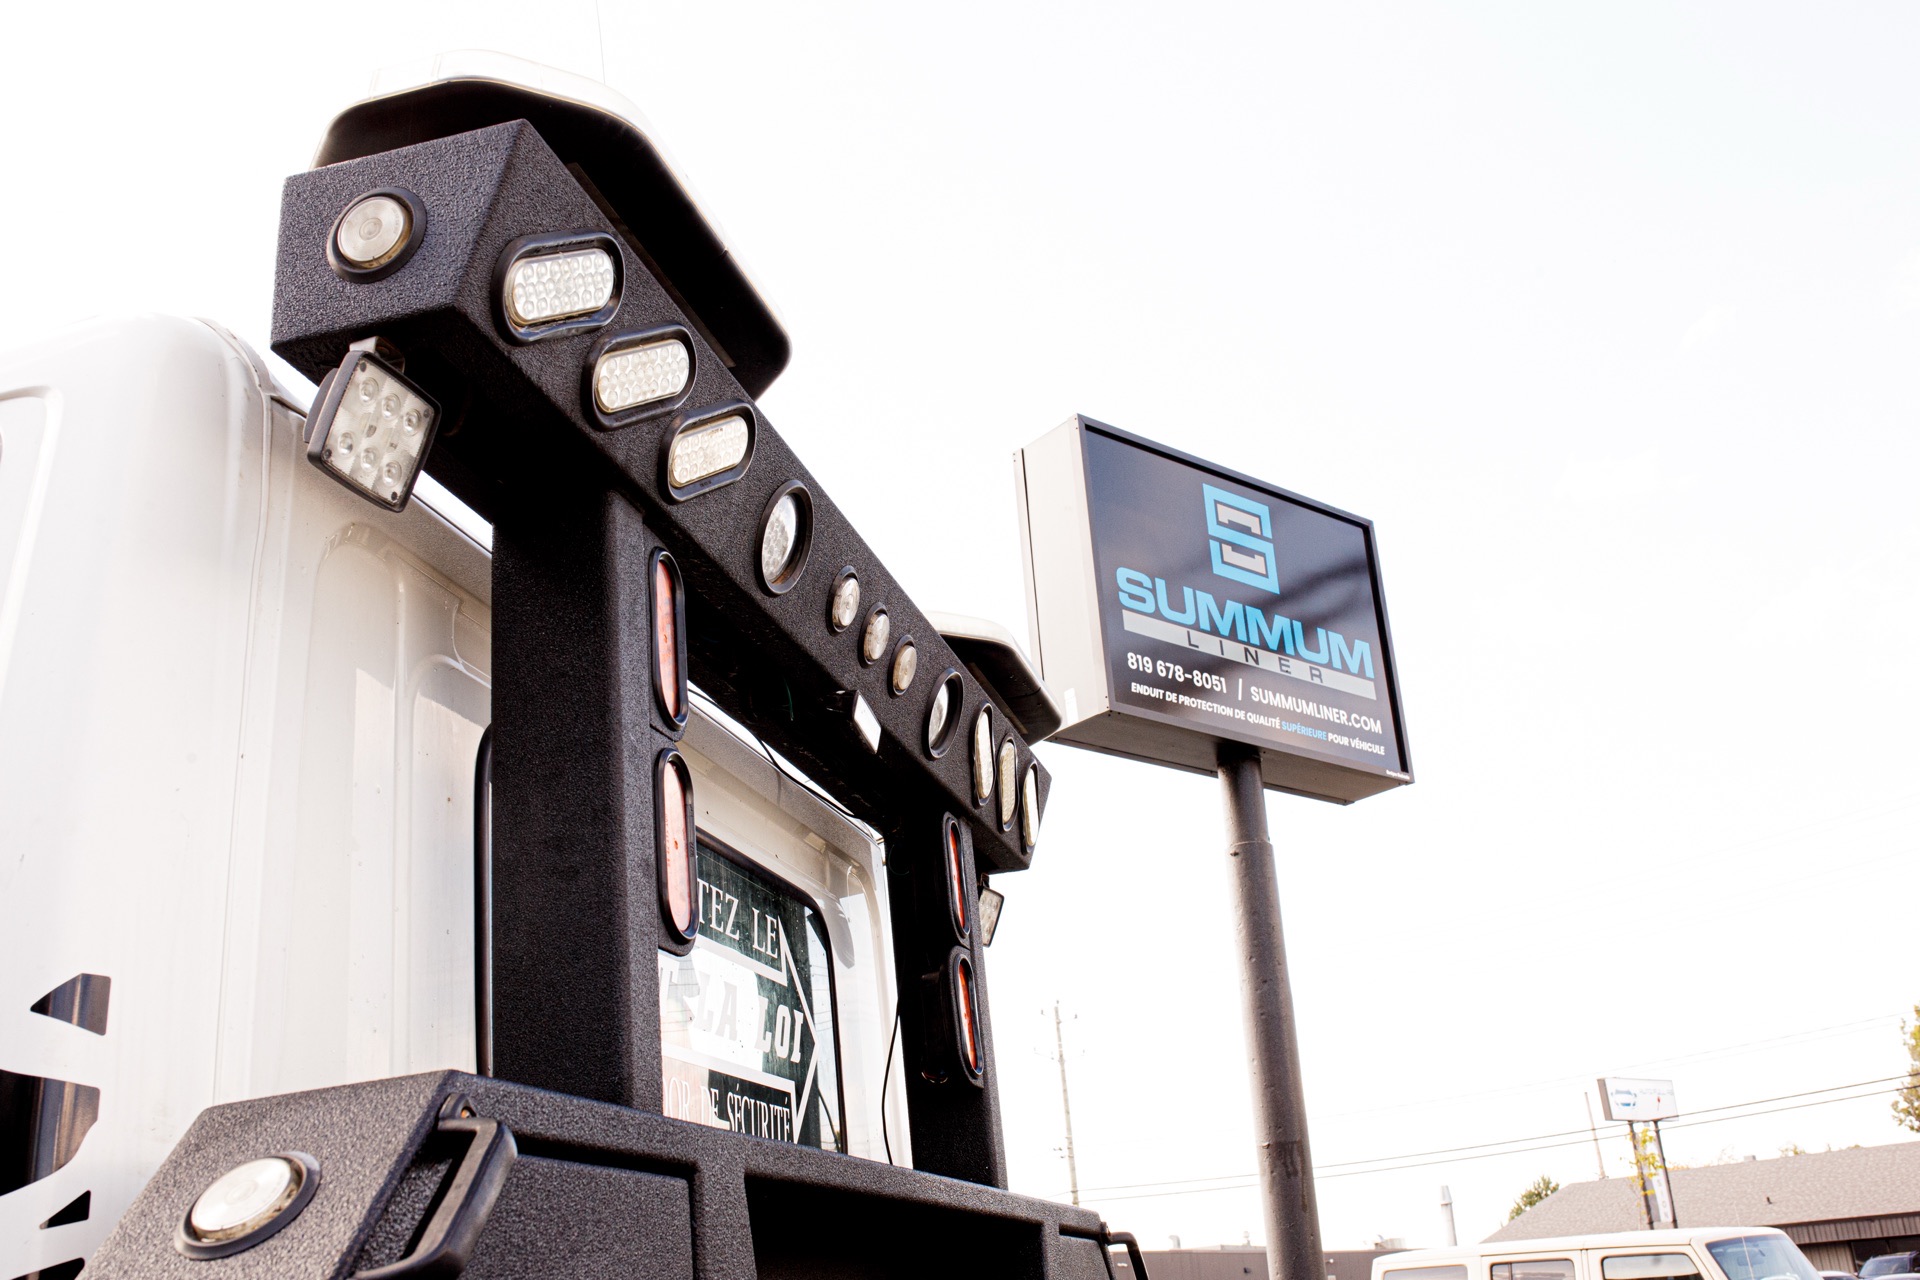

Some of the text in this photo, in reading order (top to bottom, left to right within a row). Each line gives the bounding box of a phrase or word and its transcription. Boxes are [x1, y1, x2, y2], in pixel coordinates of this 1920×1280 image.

[1115, 566, 1375, 679] SUMMUM
[1187, 630, 1324, 684] LINER
[1127, 652, 1153, 674] 819
[1156, 660, 1227, 694] 678-8051
[1250, 686, 1383, 735] SUMMUMLINER.COM
[1131, 682, 1386, 756] ENDUIT DE PROTECTION DE QUALITÉ SUPÉRIEURE POUR VÉHICULE
[751, 907, 778, 959] LE
[754, 995, 804, 1064] LOI
[700, 1085, 719, 1128] DE
[727, 1083, 791, 1143] SÉCURITÉ
